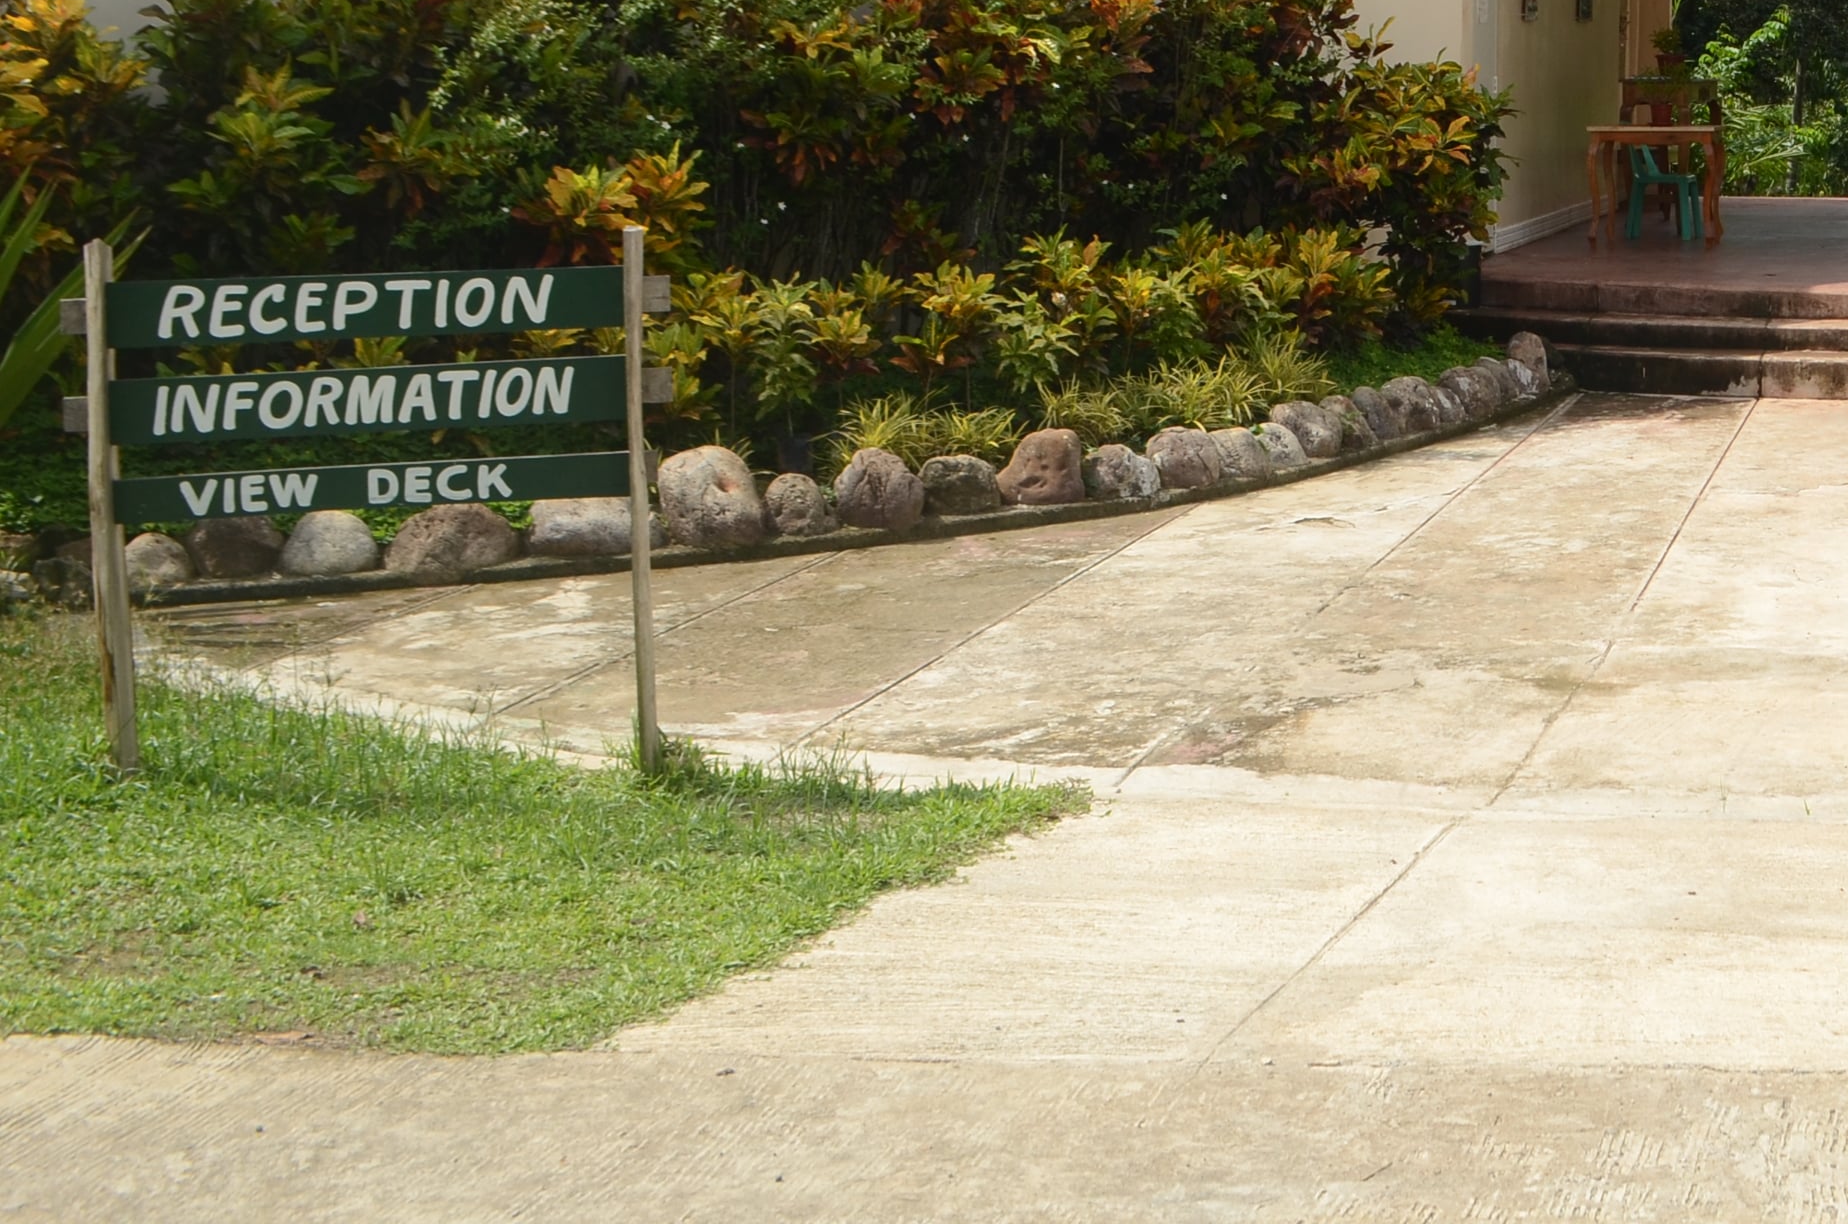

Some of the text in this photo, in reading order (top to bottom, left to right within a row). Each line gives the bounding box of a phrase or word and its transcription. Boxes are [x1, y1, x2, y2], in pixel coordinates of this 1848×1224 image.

[158, 274, 554, 339] RECEPTION
[153, 366, 574, 436] INFORMATION
[179, 463, 513, 516] VIEW DECK
